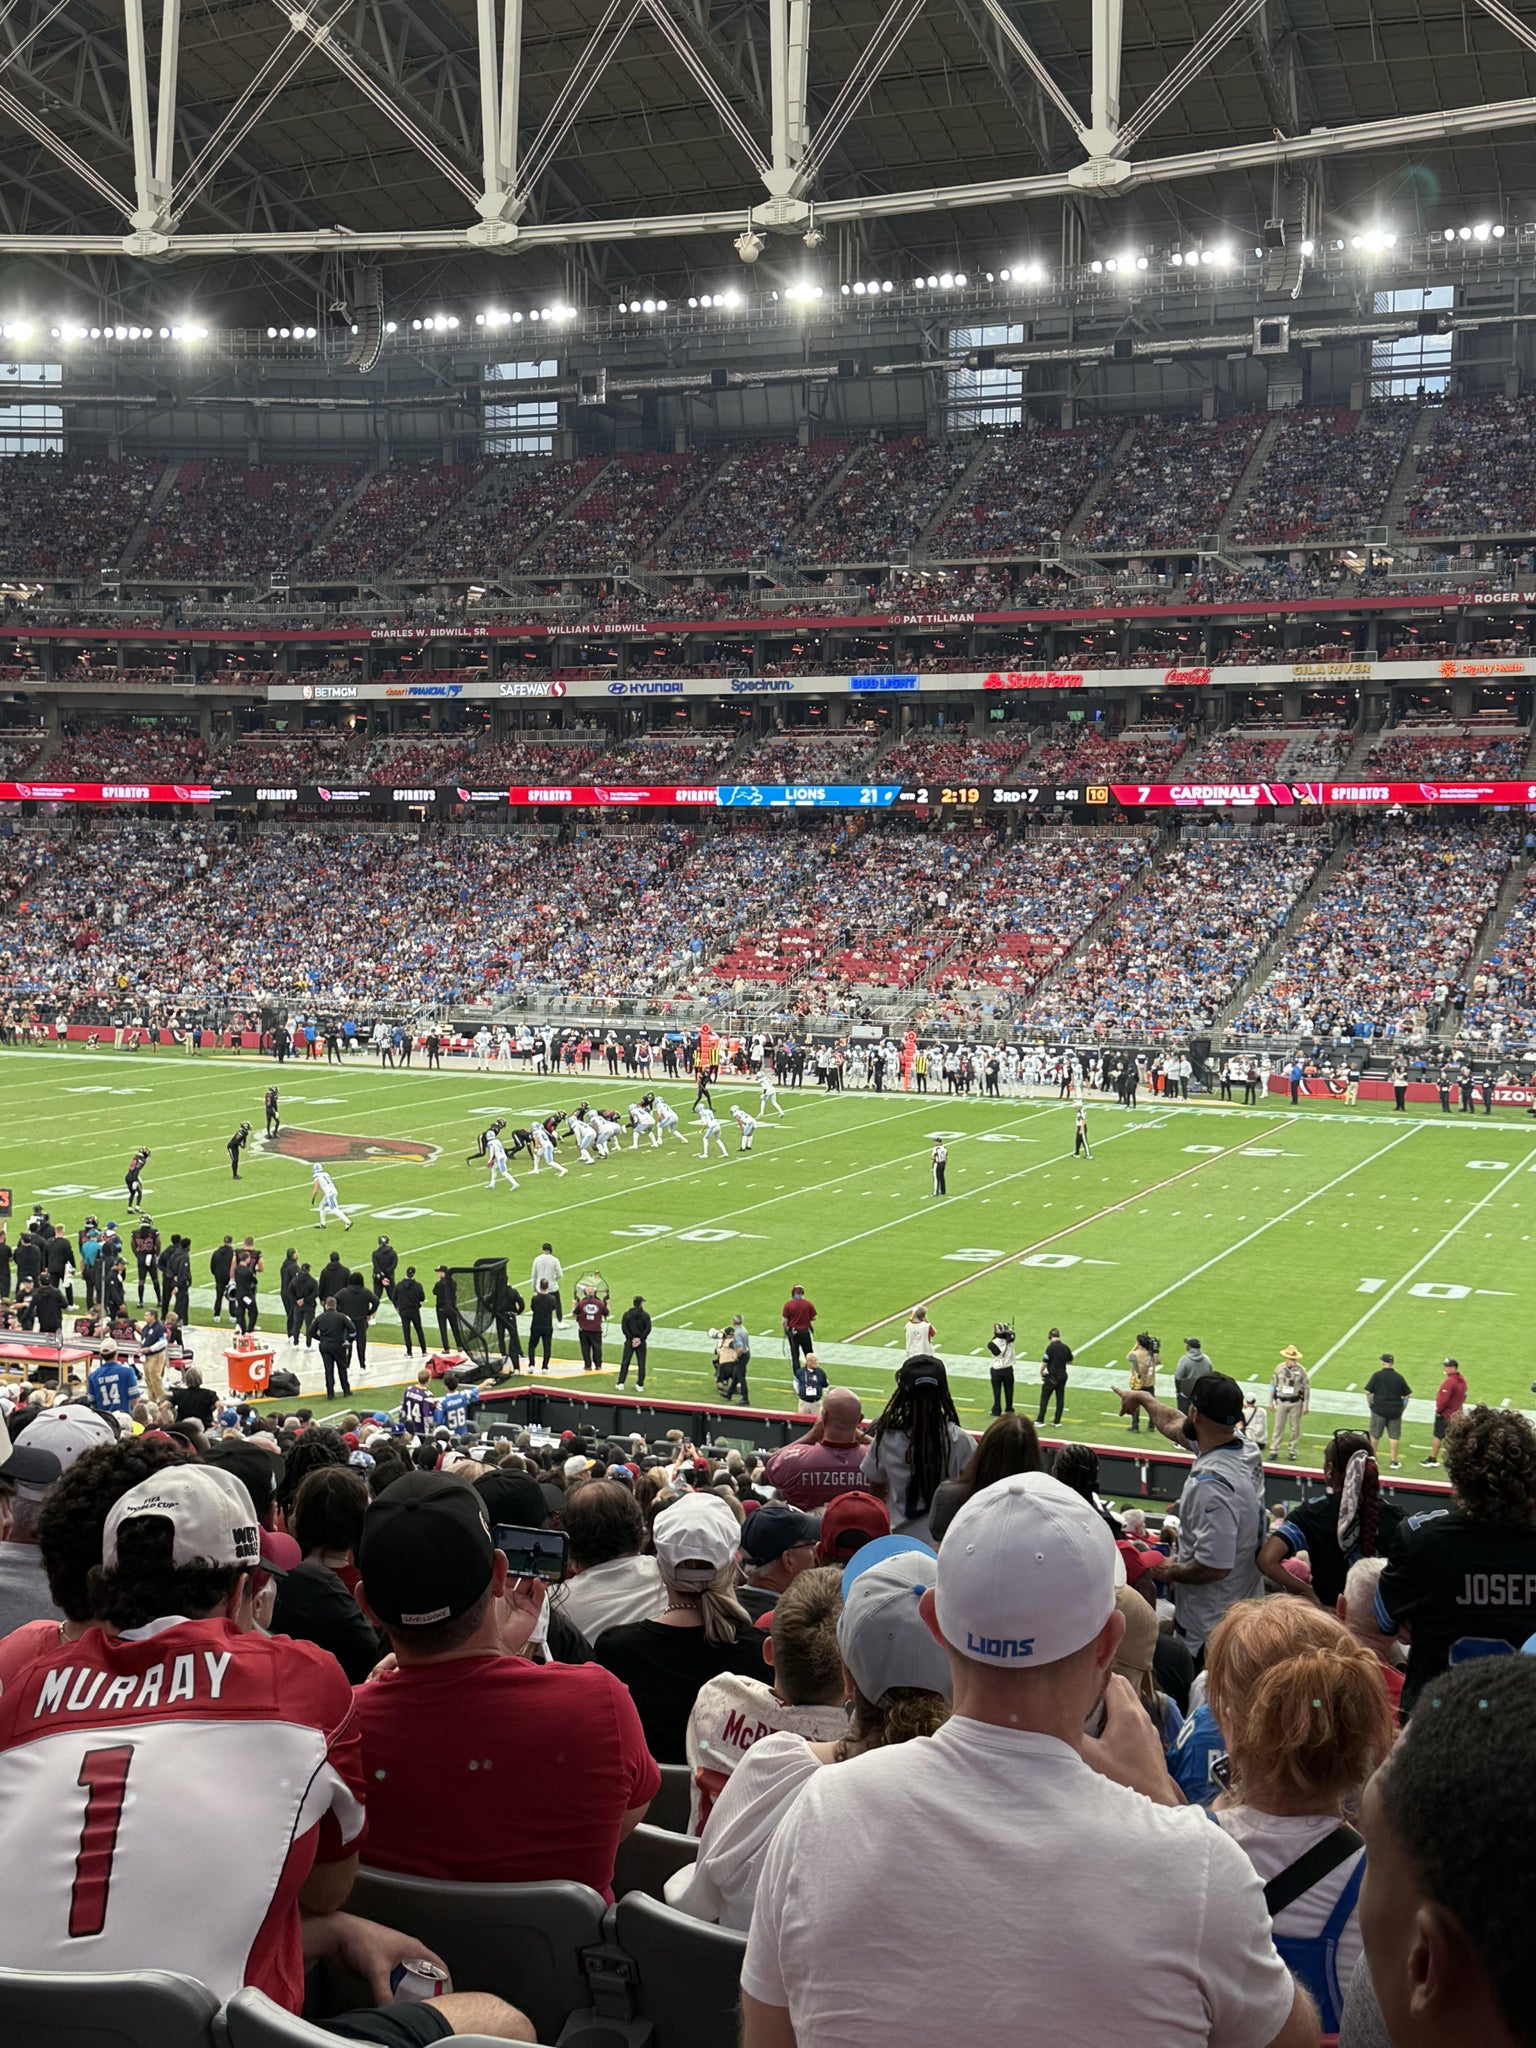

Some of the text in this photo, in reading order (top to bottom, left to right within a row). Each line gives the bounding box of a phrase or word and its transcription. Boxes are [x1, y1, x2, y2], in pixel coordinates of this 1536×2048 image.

[1457, 596, 1471, 605] 22
[1474, 592, 1519, 604] ROGER
[888, 613, 974, 624] 40 PAT TILLMAN
[371, 627, 489, 638] CHARLES W. BIDWILL, SR.
[546, 624, 647, 634] WILLIAM V. BIDWILL
[1292, 663, 1371, 675] GILA RIVER
[1460, 662, 1524, 676] Dignity Health
[731, 679, 790, 694] Spectrum
[852, 676, 916, 689] BUD LIGHT
[1006, 672, 1084, 688] State Farm
[314, 687, 357, 697] BETMGM
[408, 686, 446, 696] FINANCIAL
[500, 684, 550, 696] SAFEWAY
[629, 682, 684, 693] HYUNDAI
[785, 788, 878, 803] LIONS 21
[917, 788, 929, 803] 2
[941, 788, 980, 803] 2:19
[1090, 790, 1106, 800] 10
[1137, 786, 1260, 802] 7 CARDINALS
[297, 803, 373, 813] RISE UP RED SEA
[1356, 1277, 1472, 1300] 10
[248, 1359, 266, 1381] G
[99, 1383, 121, 1406] 14
[406, 1400, 421, 1424] 14
[447, 1407, 466, 1429] 56
[144, 1496, 160, 1504] FIFA
[967, 1631, 1035, 1658] LIONS
[33, 1651, 233, 1718] MURRAY
[67, 1744, 135, 1938] 1
